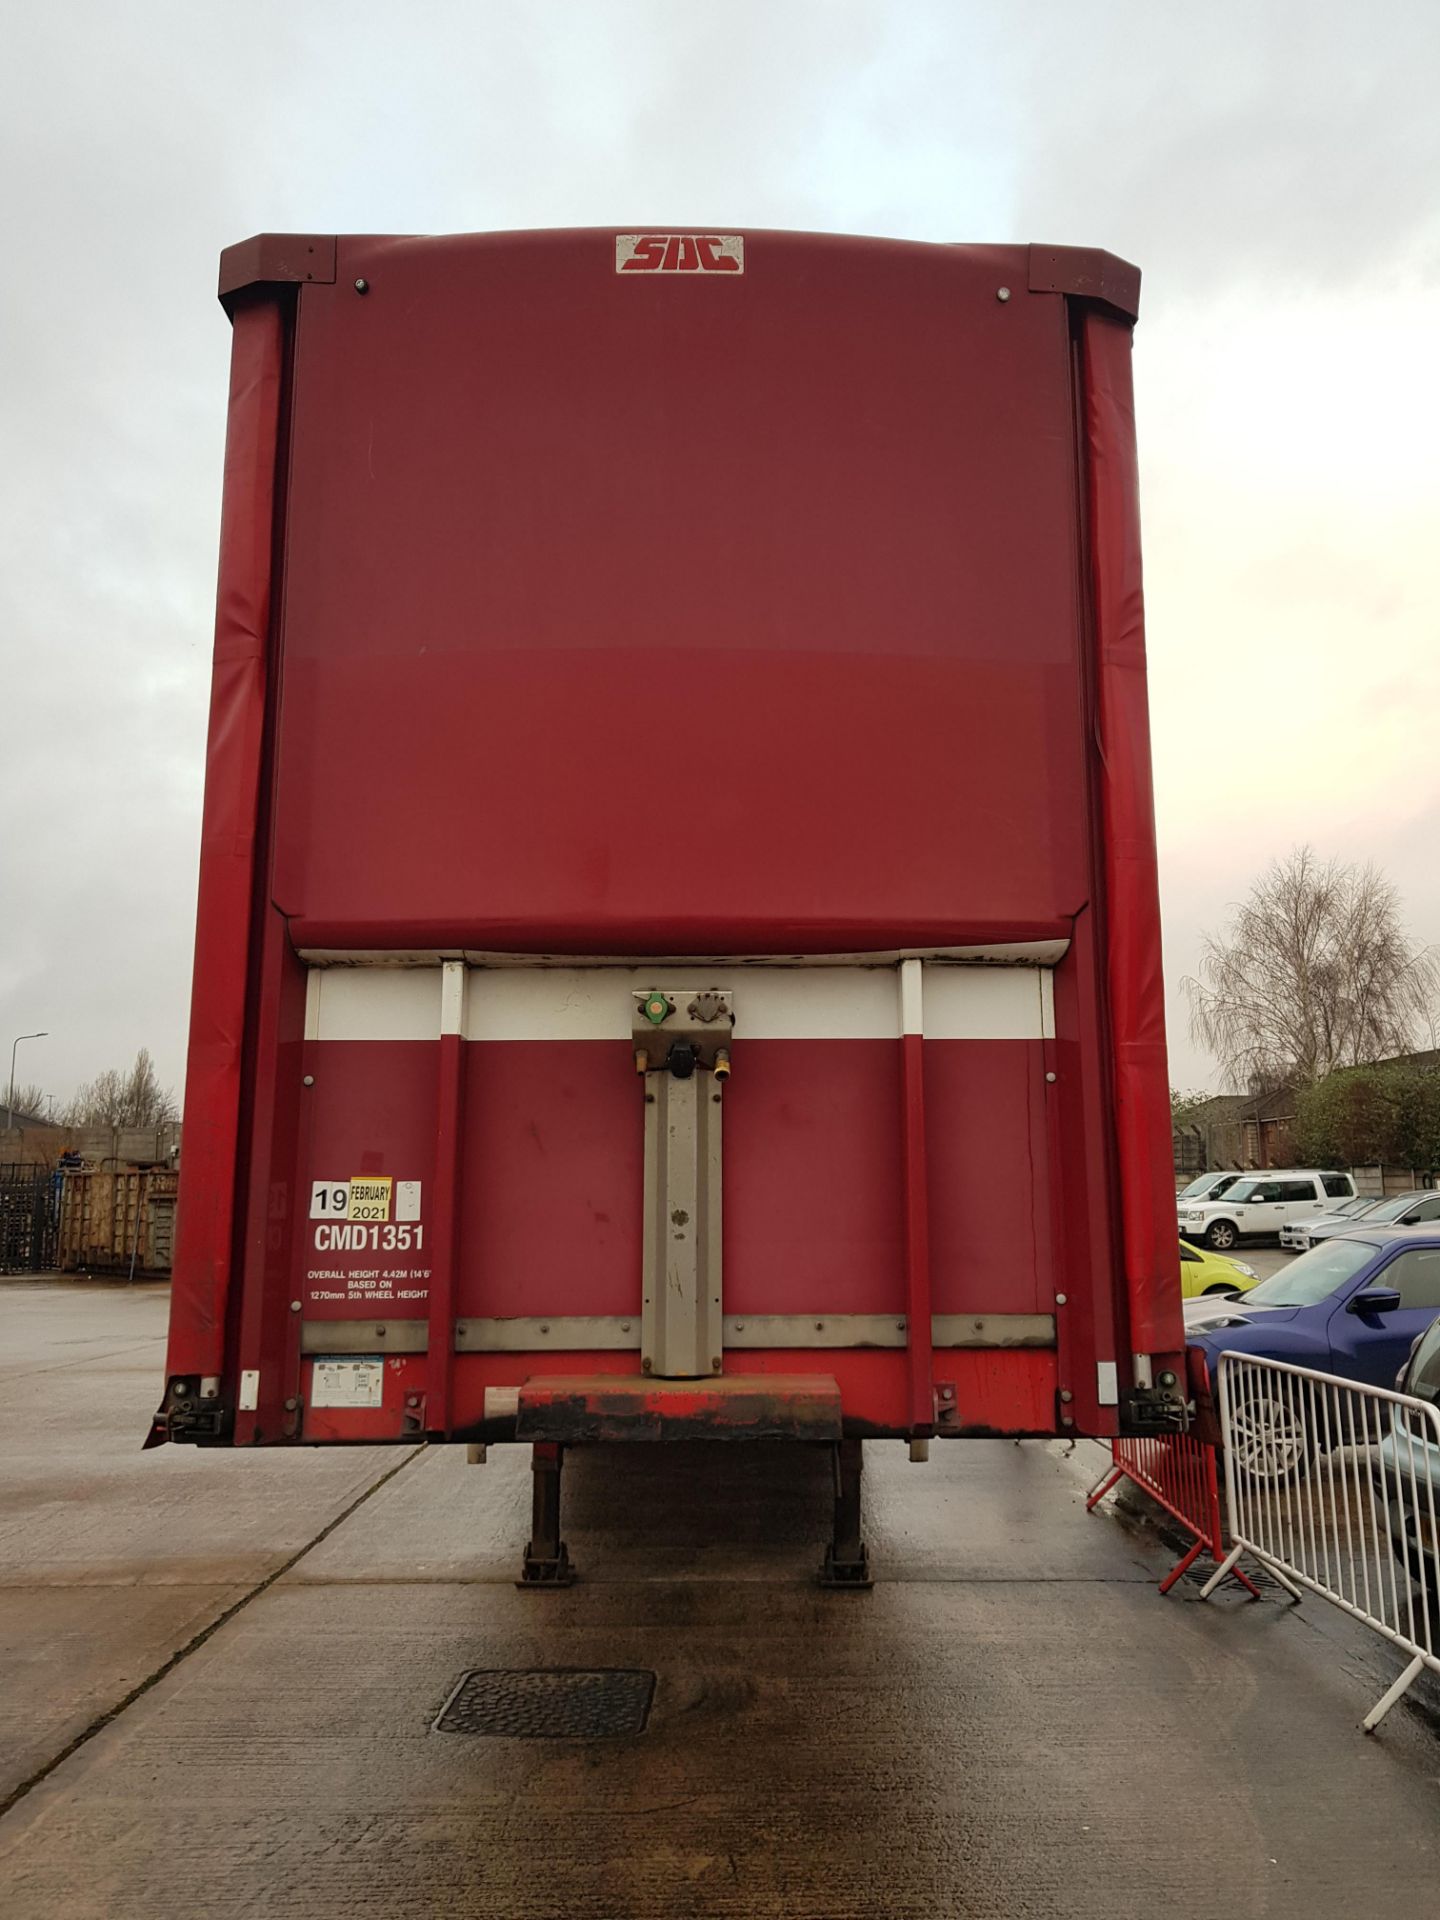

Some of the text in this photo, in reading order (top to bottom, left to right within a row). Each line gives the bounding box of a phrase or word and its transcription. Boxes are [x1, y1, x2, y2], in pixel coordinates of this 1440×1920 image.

[621, 236, 740, 270] SDC
[351, 1186, 390, 1200] FEBRUARY
[315, 1188, 348, 1212] 19
[352, 1206, 386, 1219] 2021
[315, 1225, 423, 1250] CMD1351
[307, 1270, 346, 1279] OVERALL
[348, 1270, 380, 1279] HEIGHT
[382, 1270, 408, 1279] 4.42M
[347, 1280, 393, 1289] BASED ON
[310, 1290, 429, 1300] 1270mm 5th WHEEL HEIGHT
